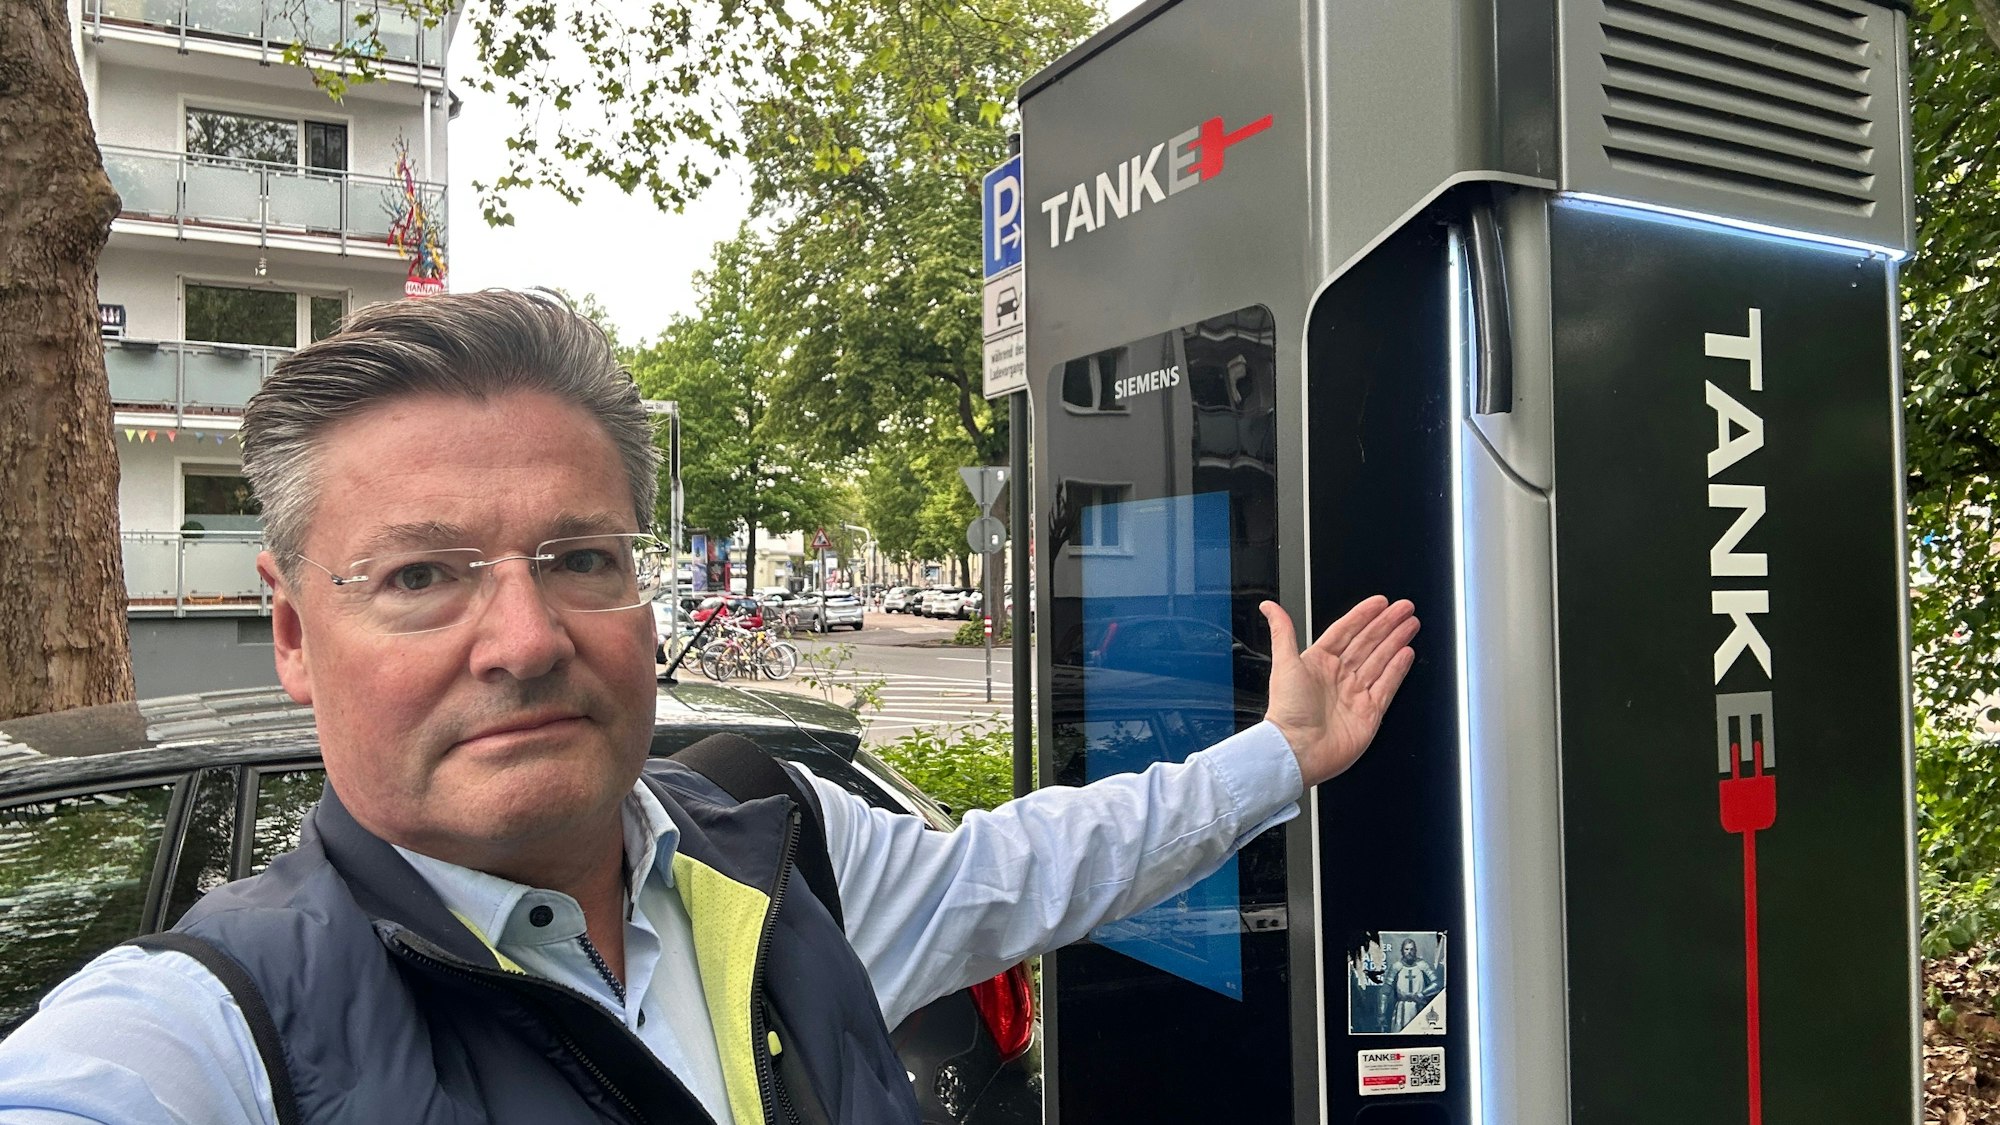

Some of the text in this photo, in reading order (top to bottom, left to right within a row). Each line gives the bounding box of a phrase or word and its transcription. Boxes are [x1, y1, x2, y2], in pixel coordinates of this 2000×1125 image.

[993, 175, 1021, 262] P
[1041, 125, 1200, 248] TANKE
[1114, 365, 1180, 400] SIEMENS
[1704, 307, 1776, 774] TANKE
[1362, 1053, 1397, 1062] TANKE
